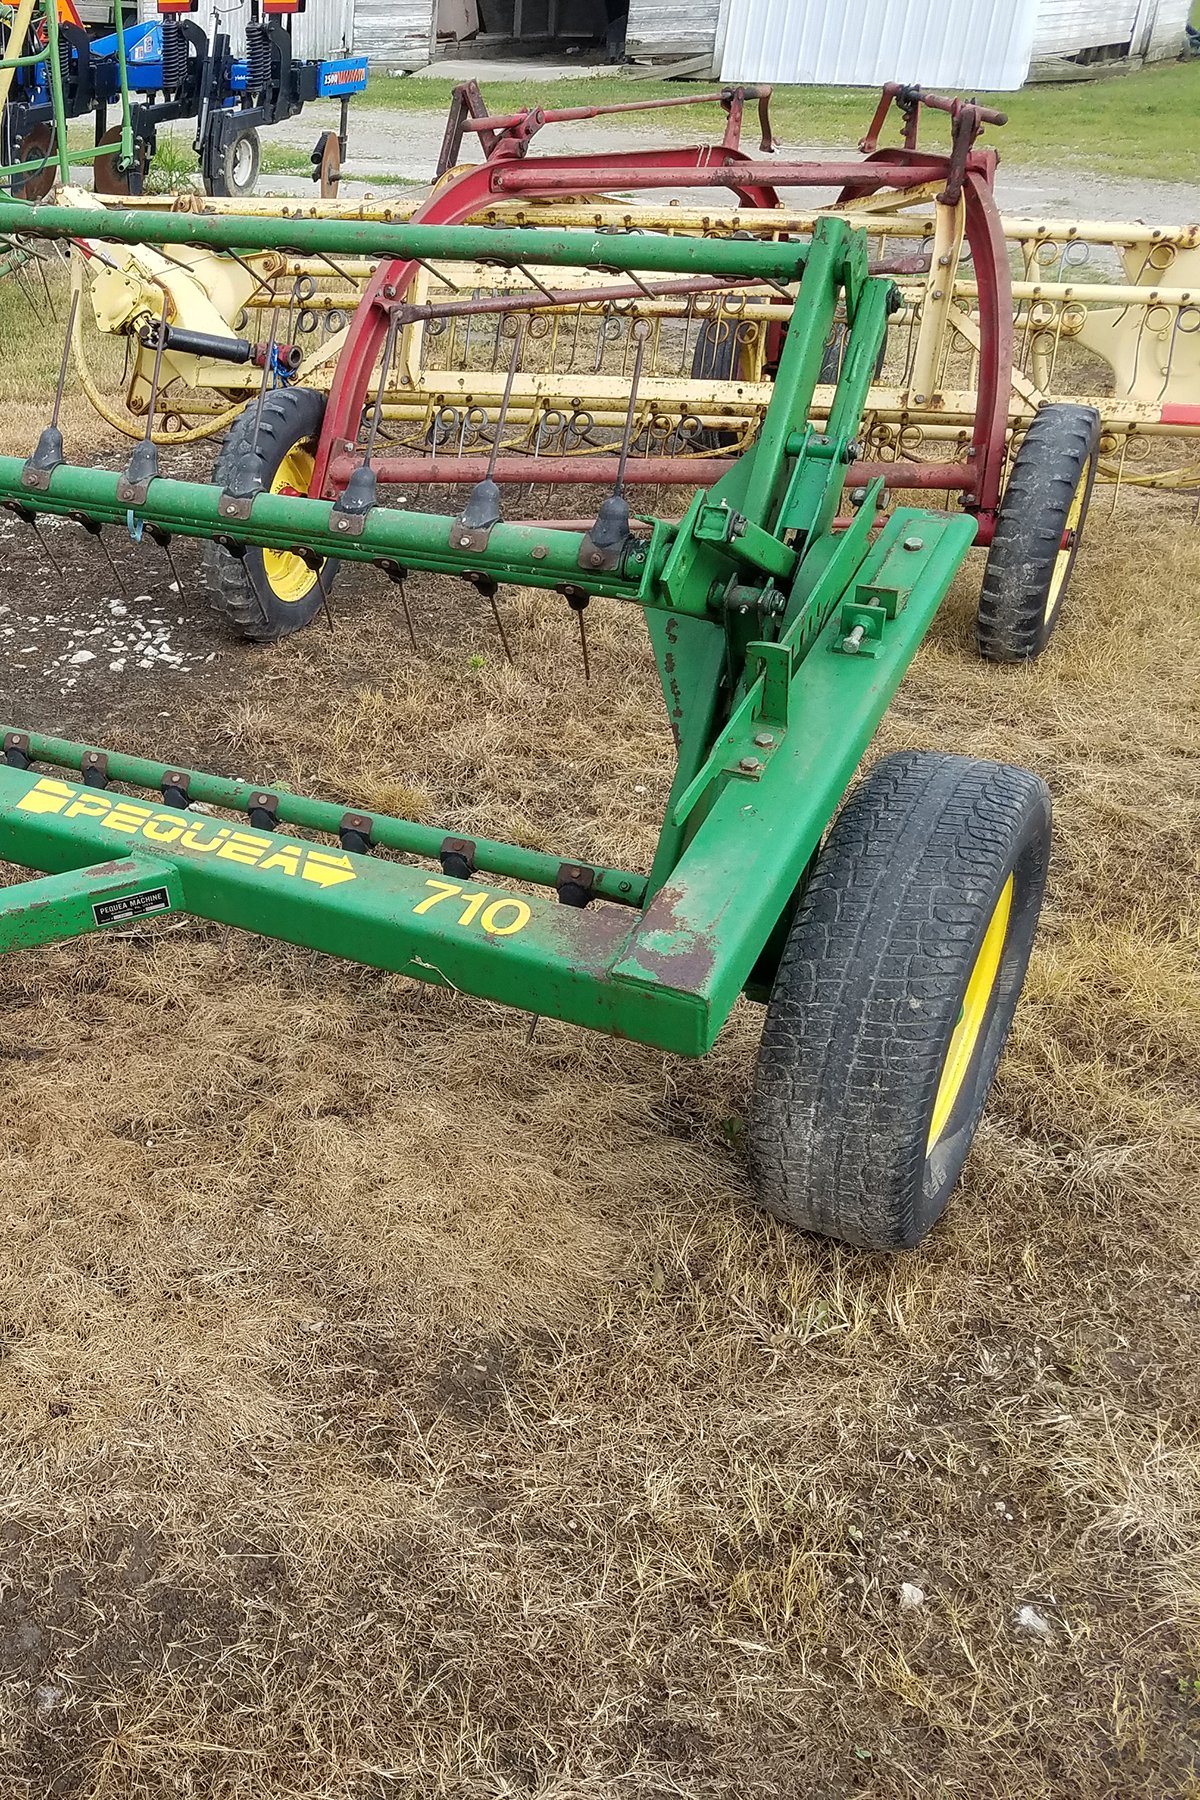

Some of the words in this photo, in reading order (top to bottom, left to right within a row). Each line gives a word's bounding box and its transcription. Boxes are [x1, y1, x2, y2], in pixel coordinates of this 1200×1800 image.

[63, 793, 303, 875] PEQUEA
[99, 902, 128, 915] PEQUEA
[129, 893, 163, 908] MACHINE
[412, 879, 531, 936] 710
